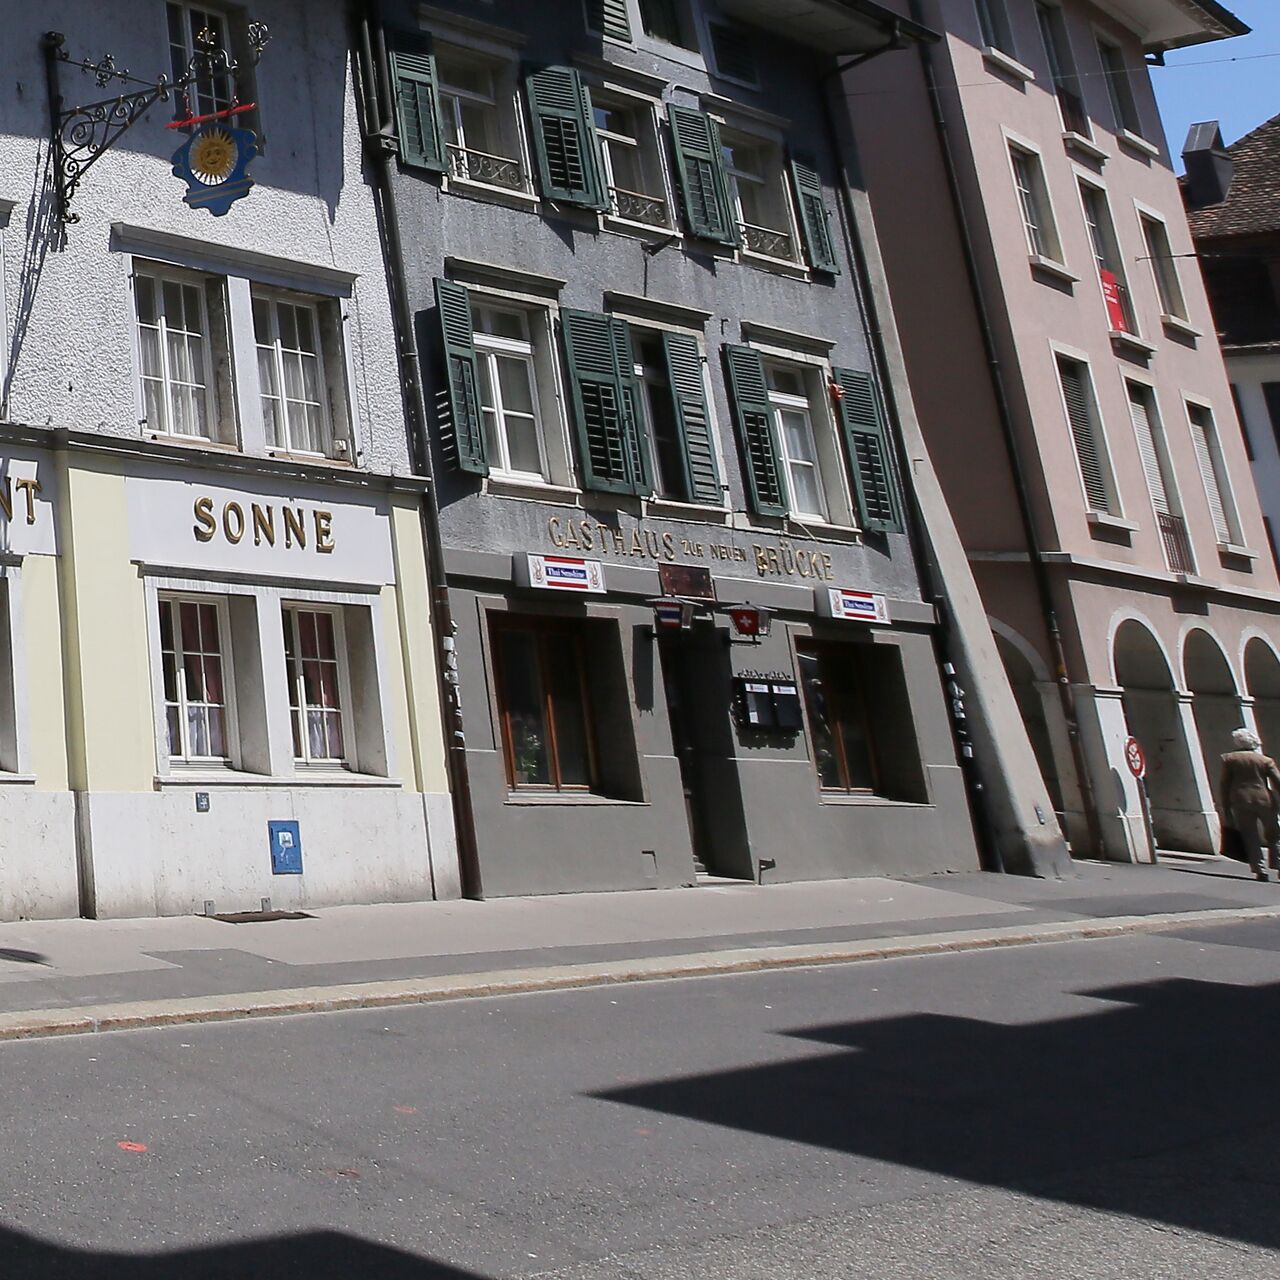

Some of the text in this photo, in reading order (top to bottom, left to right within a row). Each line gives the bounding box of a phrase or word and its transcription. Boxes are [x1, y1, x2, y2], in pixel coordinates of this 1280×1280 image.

[193, 496, 335, 553] SONNE
[548, 517, 834, 581] GASTHAUS ZUR NEUEN BRÜCKE
